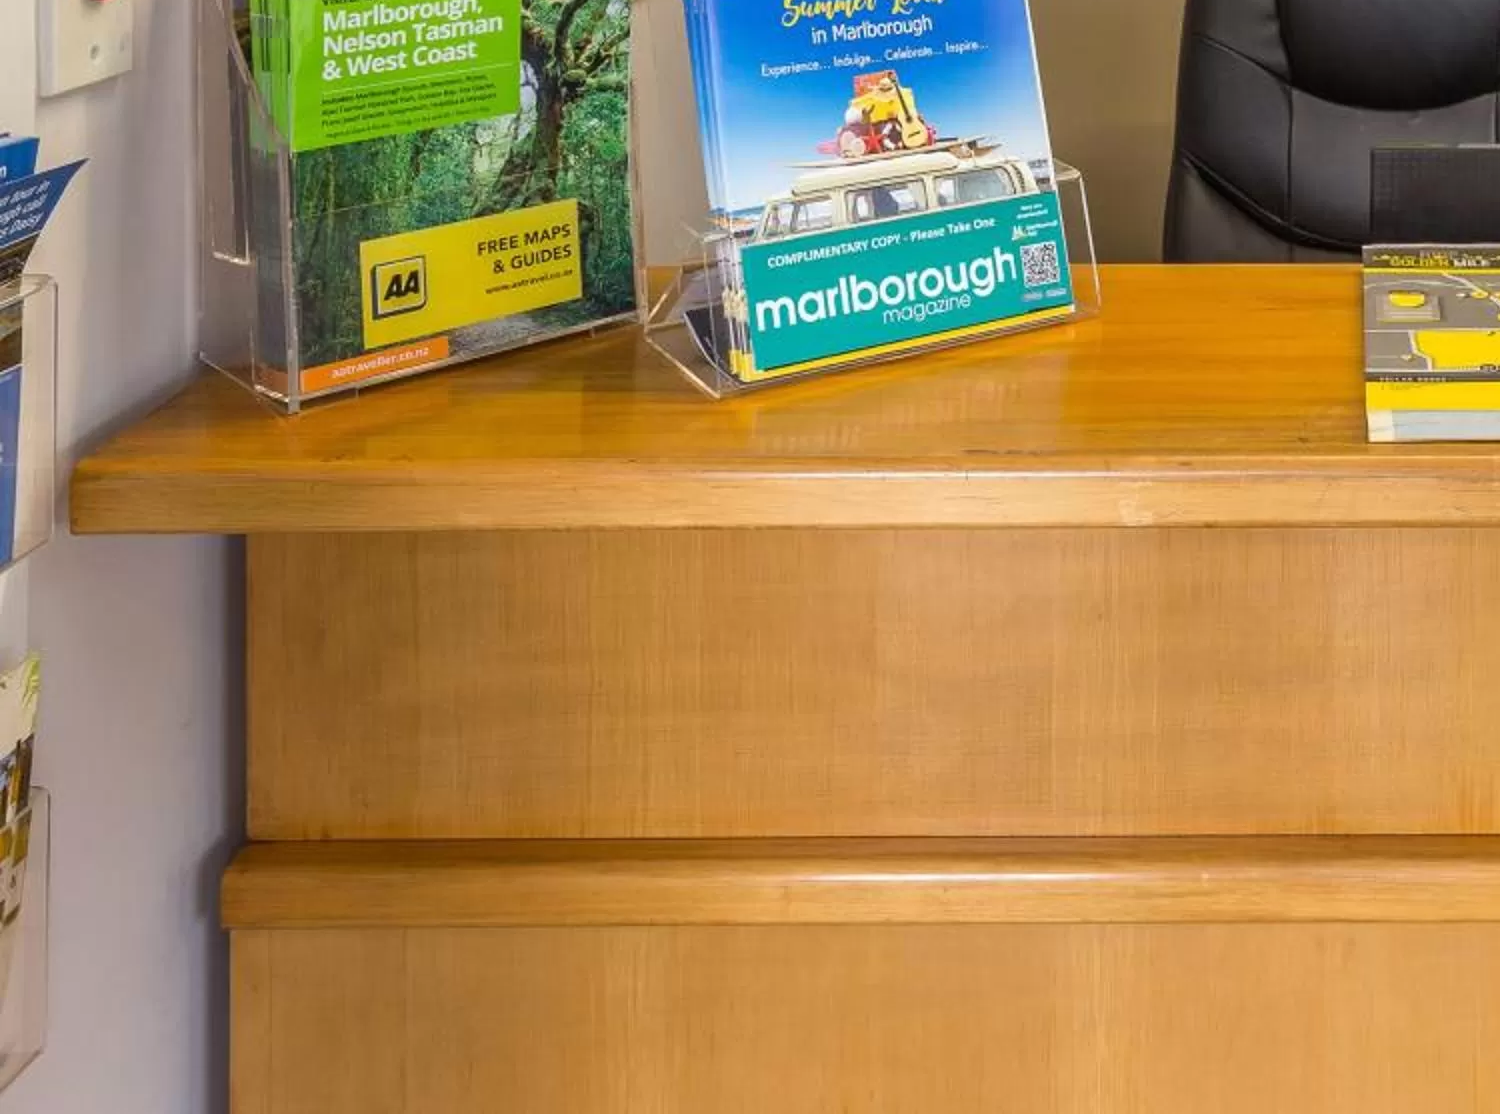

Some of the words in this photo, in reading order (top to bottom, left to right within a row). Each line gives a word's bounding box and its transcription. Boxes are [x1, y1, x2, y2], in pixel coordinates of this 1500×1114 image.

[323, 27, 407, 58] Nelson
[412, 14, 504, 44] Tasman
[811, 26, 828, 46] in
[832, 15, 934, 43] Marlborough
[321, 59, 342, 82] &
[346, 48, 408, 78] West
[412, 39, 478, 69] Coast
[477, 237, 519, 258] FREE
[523, 223, 573, 245] MAPS
[766, 238, 869, 270] COMPLIMENTARY
[871, 232, 901, 251] COPY
[910, 223, 946, 244] Please
[947, 219, 972, 236] Take
[972, 216, 996, 232] One
[492, 259, 506, 275] &
[510, 245, 573, 271] GUIDES
[1389, 255, 1449, 267] GOLDEN
[382, 268, 422, 303] AA
[754, 244, 1018, 332] marlborough
[882, 292, 973, 325] magazine
